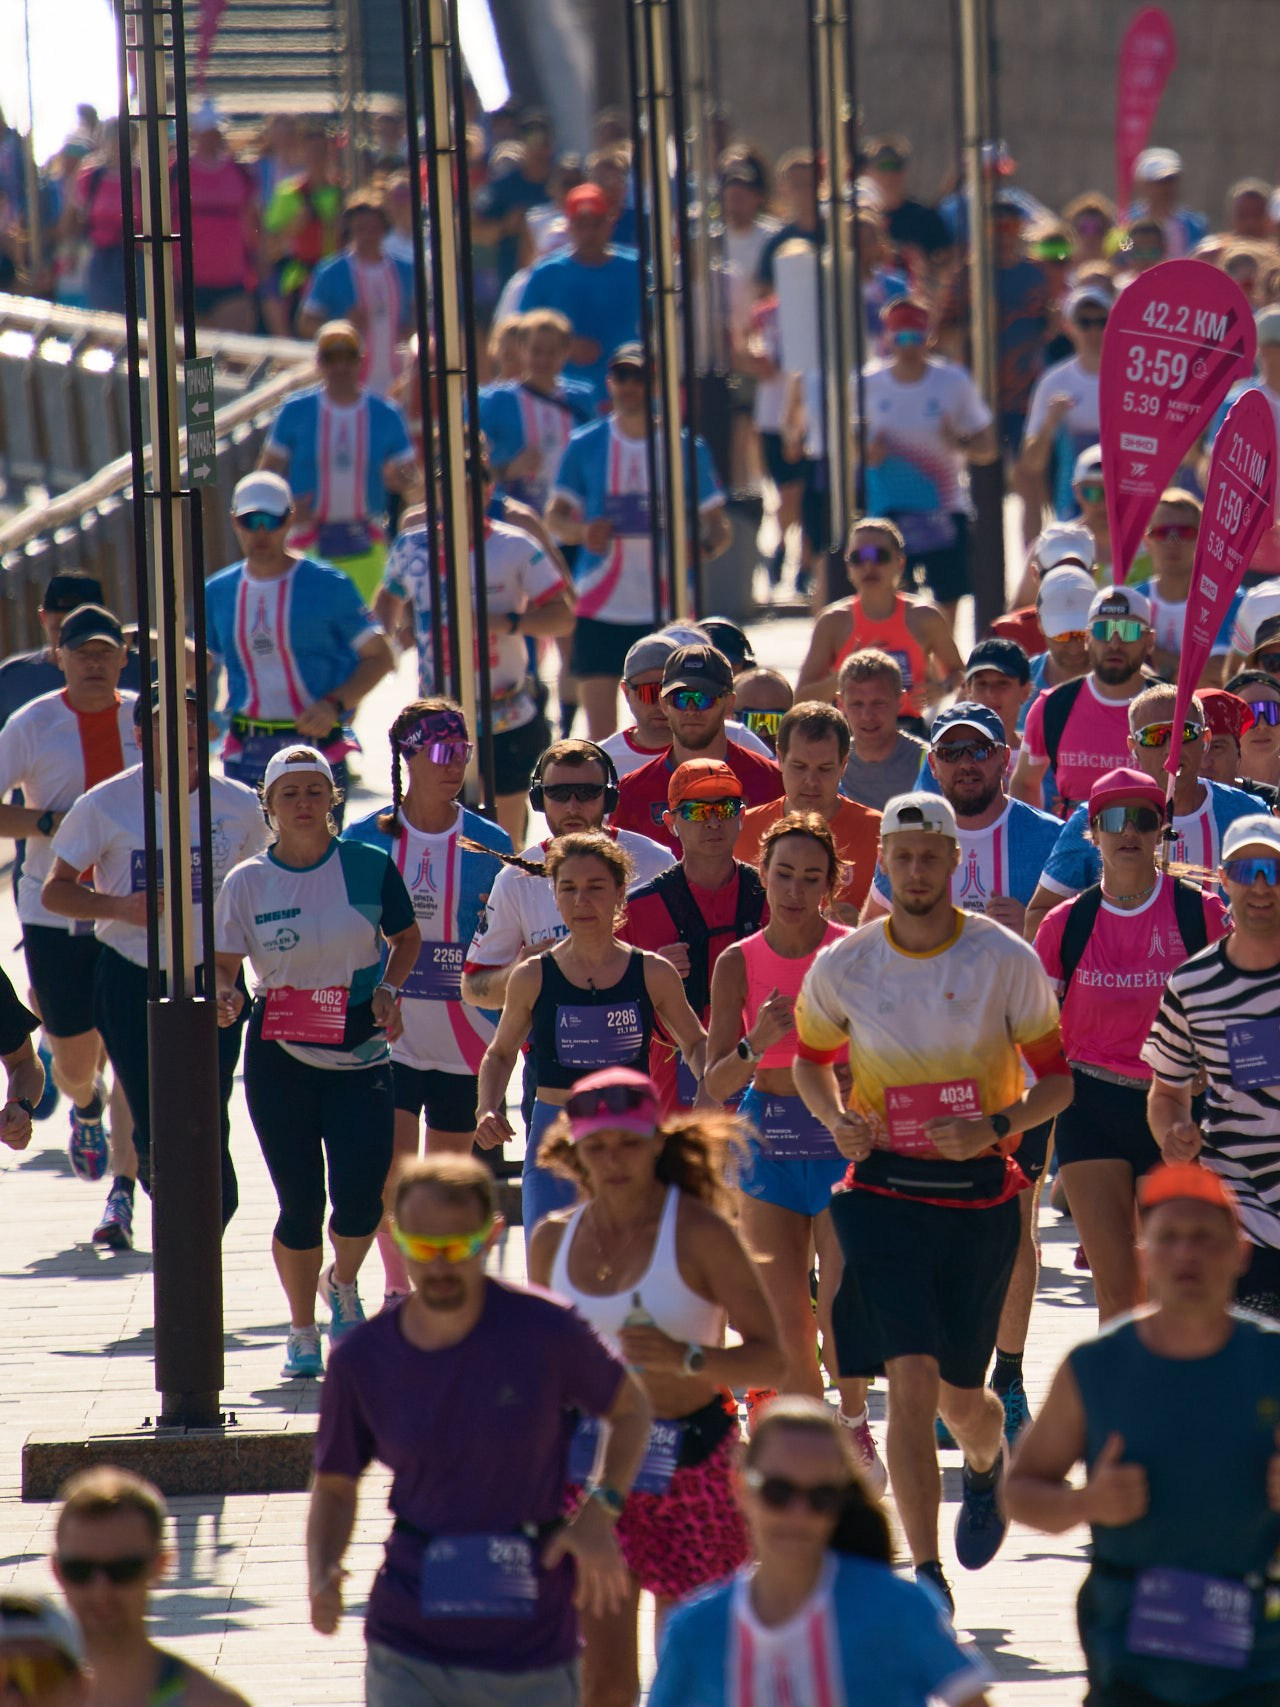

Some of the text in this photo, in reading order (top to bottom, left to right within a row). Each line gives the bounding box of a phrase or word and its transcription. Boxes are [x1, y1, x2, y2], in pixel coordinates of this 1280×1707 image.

[1142, 300, 1229, 343] 42,2 КМ
[1126, 345, 1188, 390] 3:59
[1122, 391, 1160, 416] 5.39
[1167, 400, 1201, 415] минут
[1228, 431, 1267, 489] 21,1 КМ
[1215, 481, 1243, 536] 1:59
[1207, 530, 1225, 562] 5.38
[1059, 751, 1142, 771] ПЕЙСМЕЙ
[255, 907, 302, 925] СИБУР
[433, 948, 463, 964] 2256
[311, 989, 343, 1005] 4062
[607, 1008, 637, 1028] 2286
[940, 1085, 975, 1105] 4034
